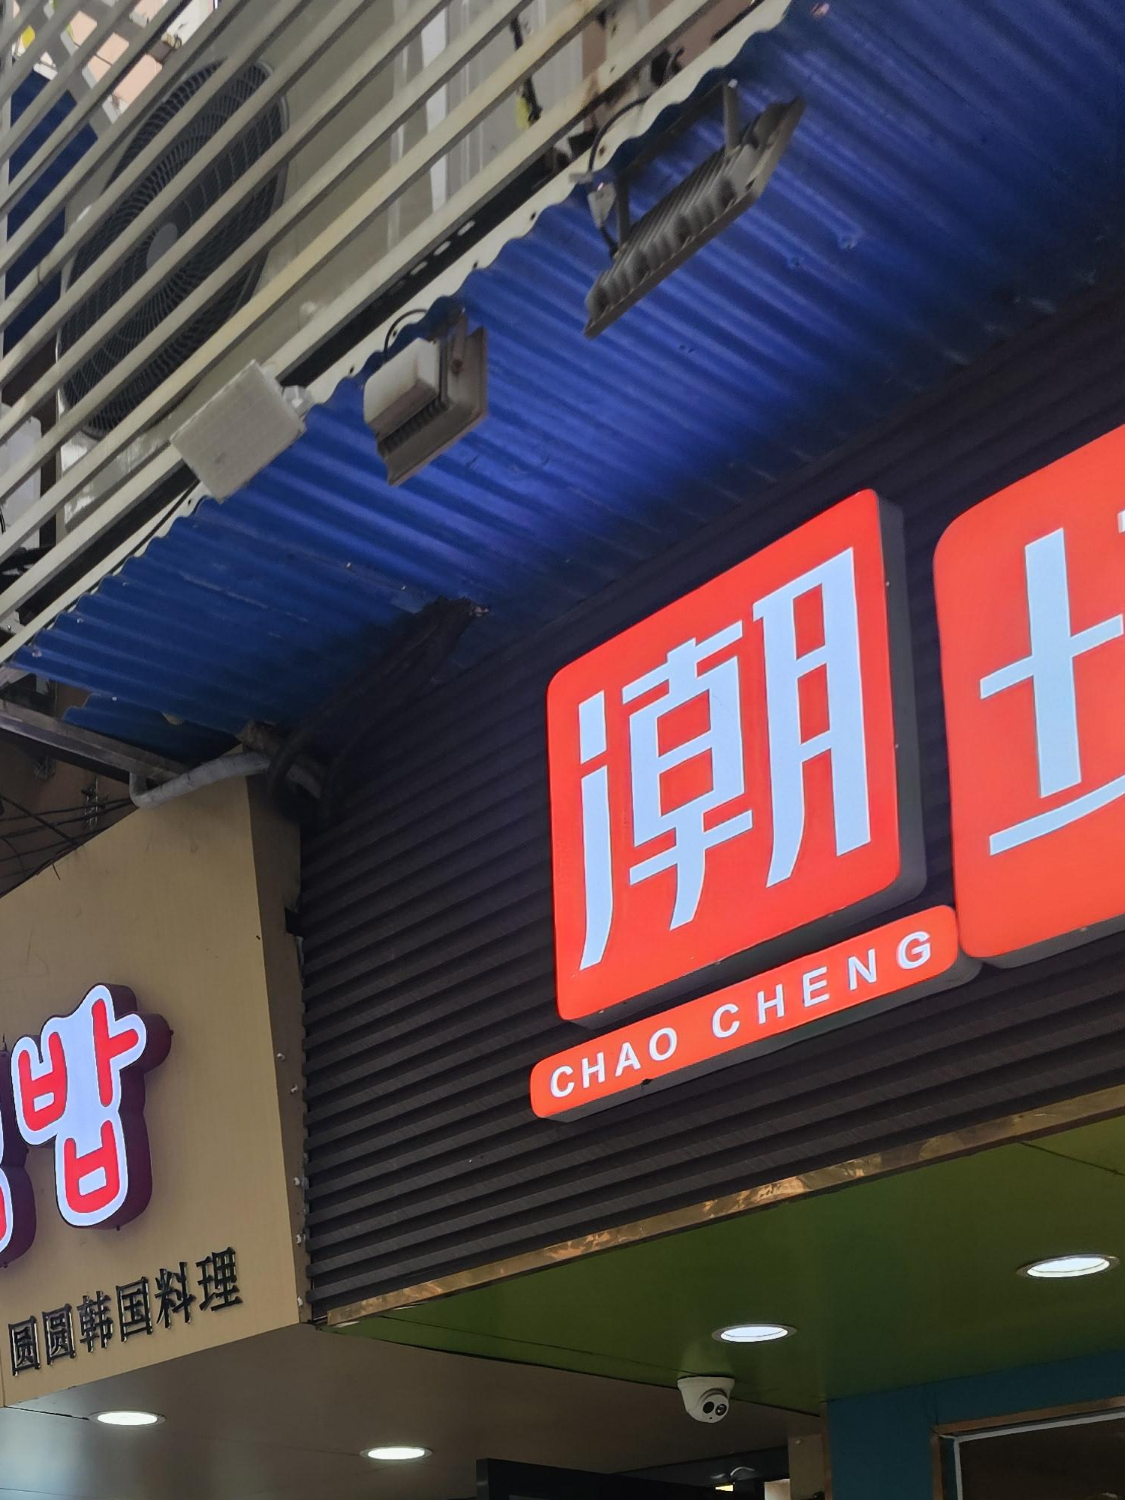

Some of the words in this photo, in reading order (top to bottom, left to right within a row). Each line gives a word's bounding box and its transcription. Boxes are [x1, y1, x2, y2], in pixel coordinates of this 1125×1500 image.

[550, 1027, 678, 1099] CHAO
[712, 930, 932, 1038] CHENG
[7, 1246, 243, 1377] 圆圆韩国料理
